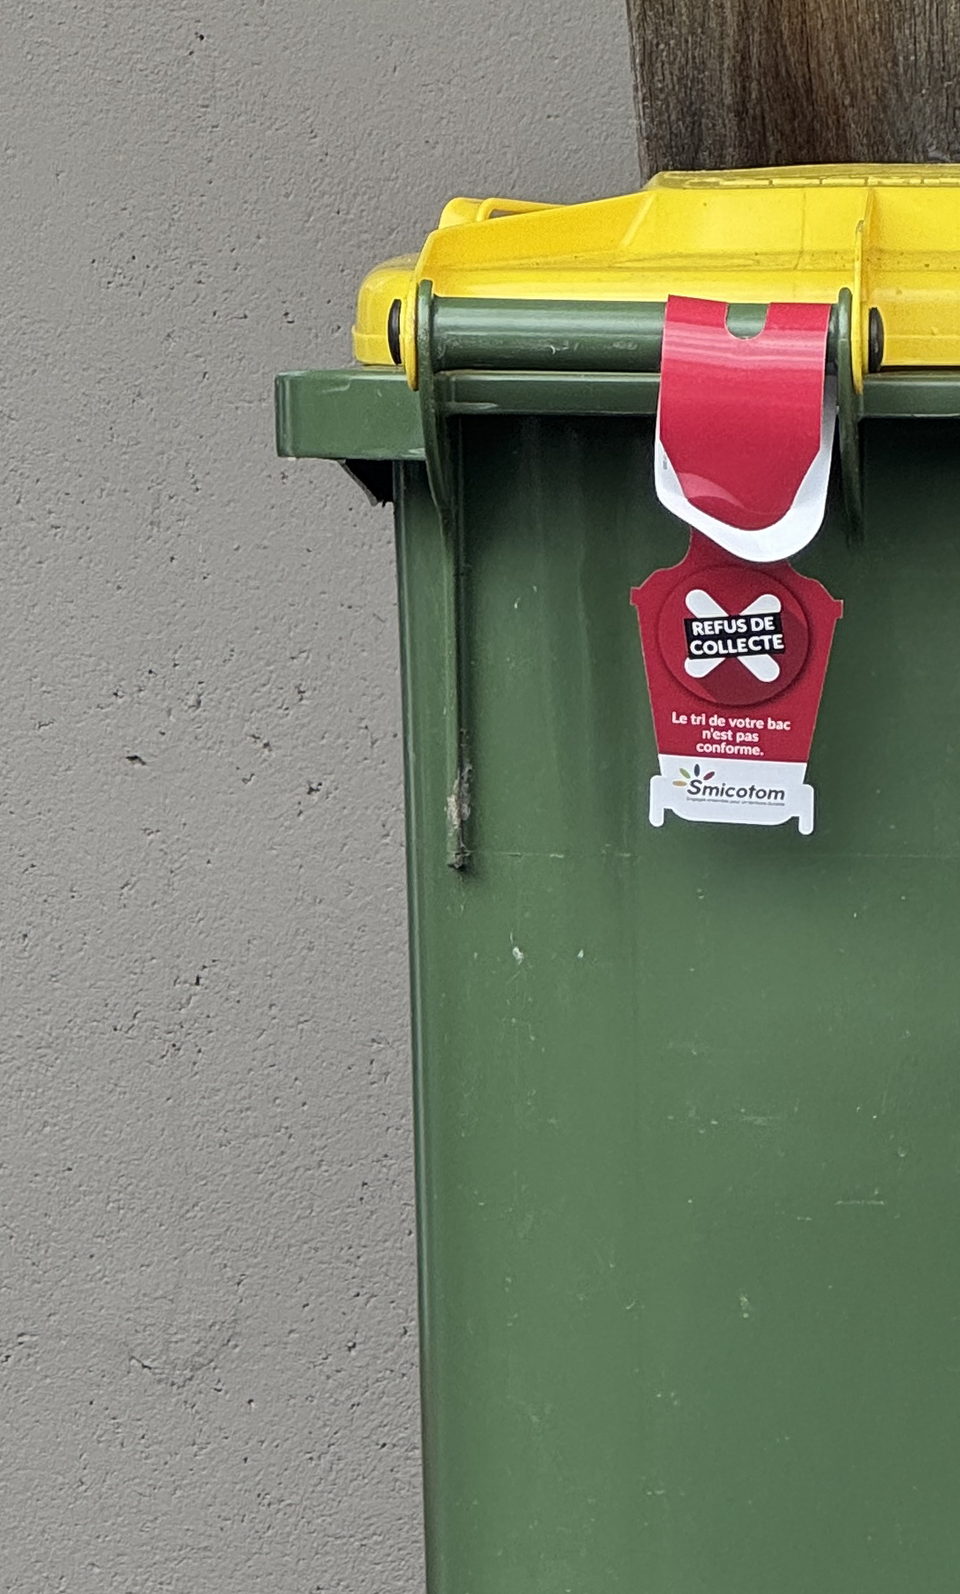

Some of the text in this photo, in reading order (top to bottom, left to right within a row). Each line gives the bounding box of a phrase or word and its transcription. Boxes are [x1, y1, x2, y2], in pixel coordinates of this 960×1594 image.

[691, 616, 775, 636] REFUS DE
[690, 634, 784, 655] COLLECTE
[672, 711, 791, 730] Le tri de votre bac
[702, 728, 759, 743] n'est pas
[696, 742, 764, 756] conforme.
[687, 779, 785, 800] Smicotom
